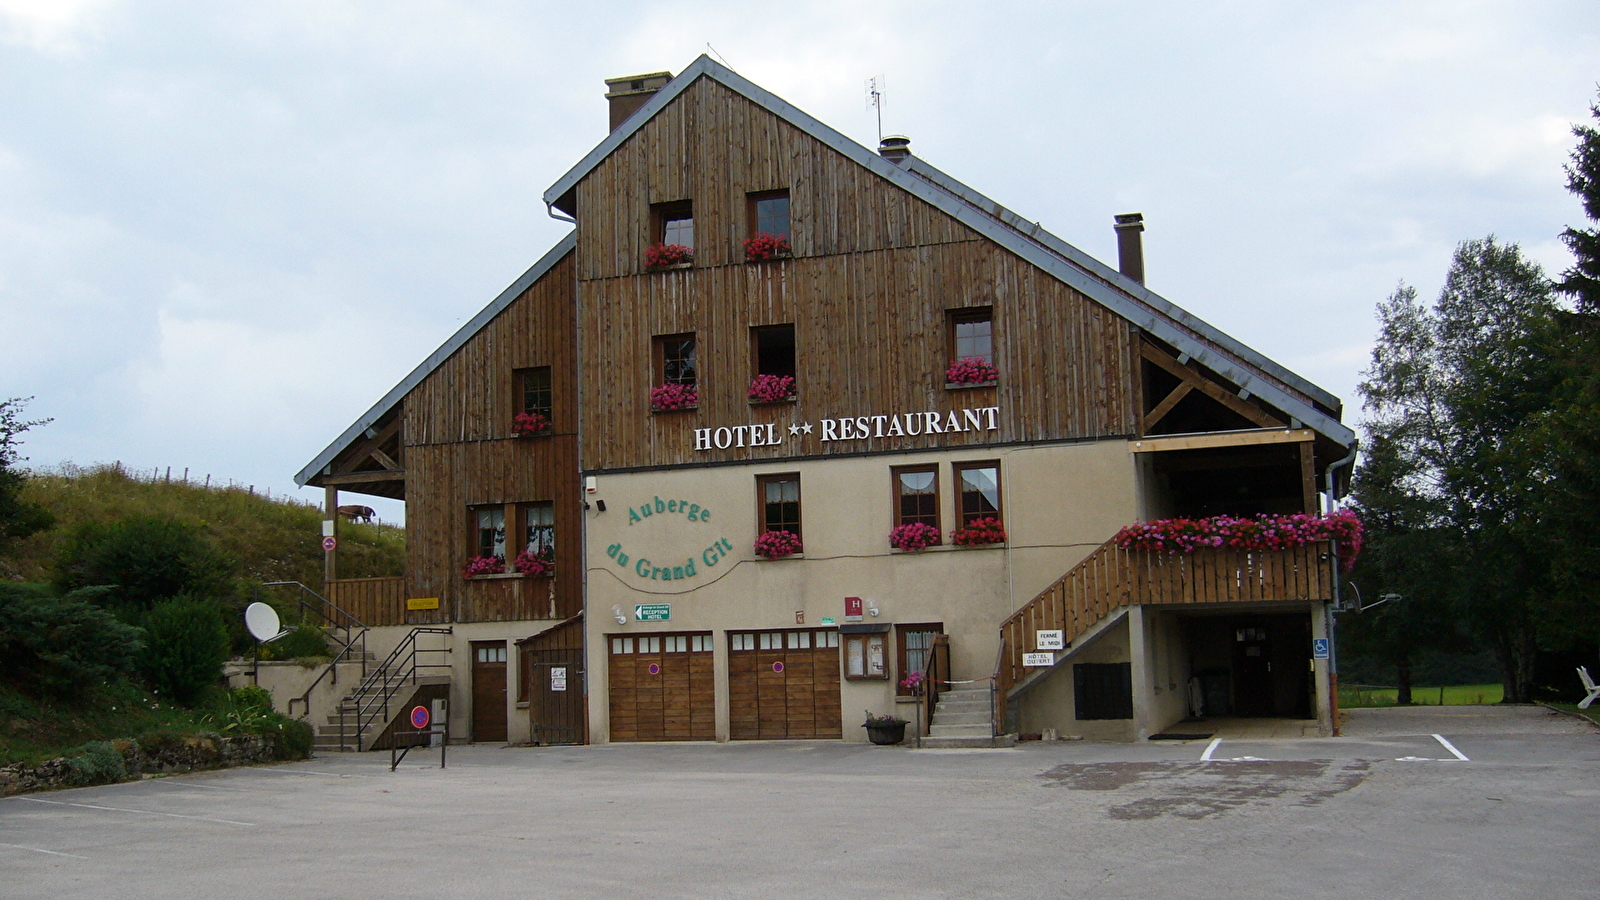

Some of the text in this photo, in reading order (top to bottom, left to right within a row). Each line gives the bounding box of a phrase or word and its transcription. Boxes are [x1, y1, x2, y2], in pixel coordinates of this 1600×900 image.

[694, 407, 1000, 451] HOTEL RESTAURANT
[628, 495, 711, 526] Auberge
[606, 543, 630, 567] du
[635, 557, 697, 581] Grand
[852, 600, 860, 608] H
